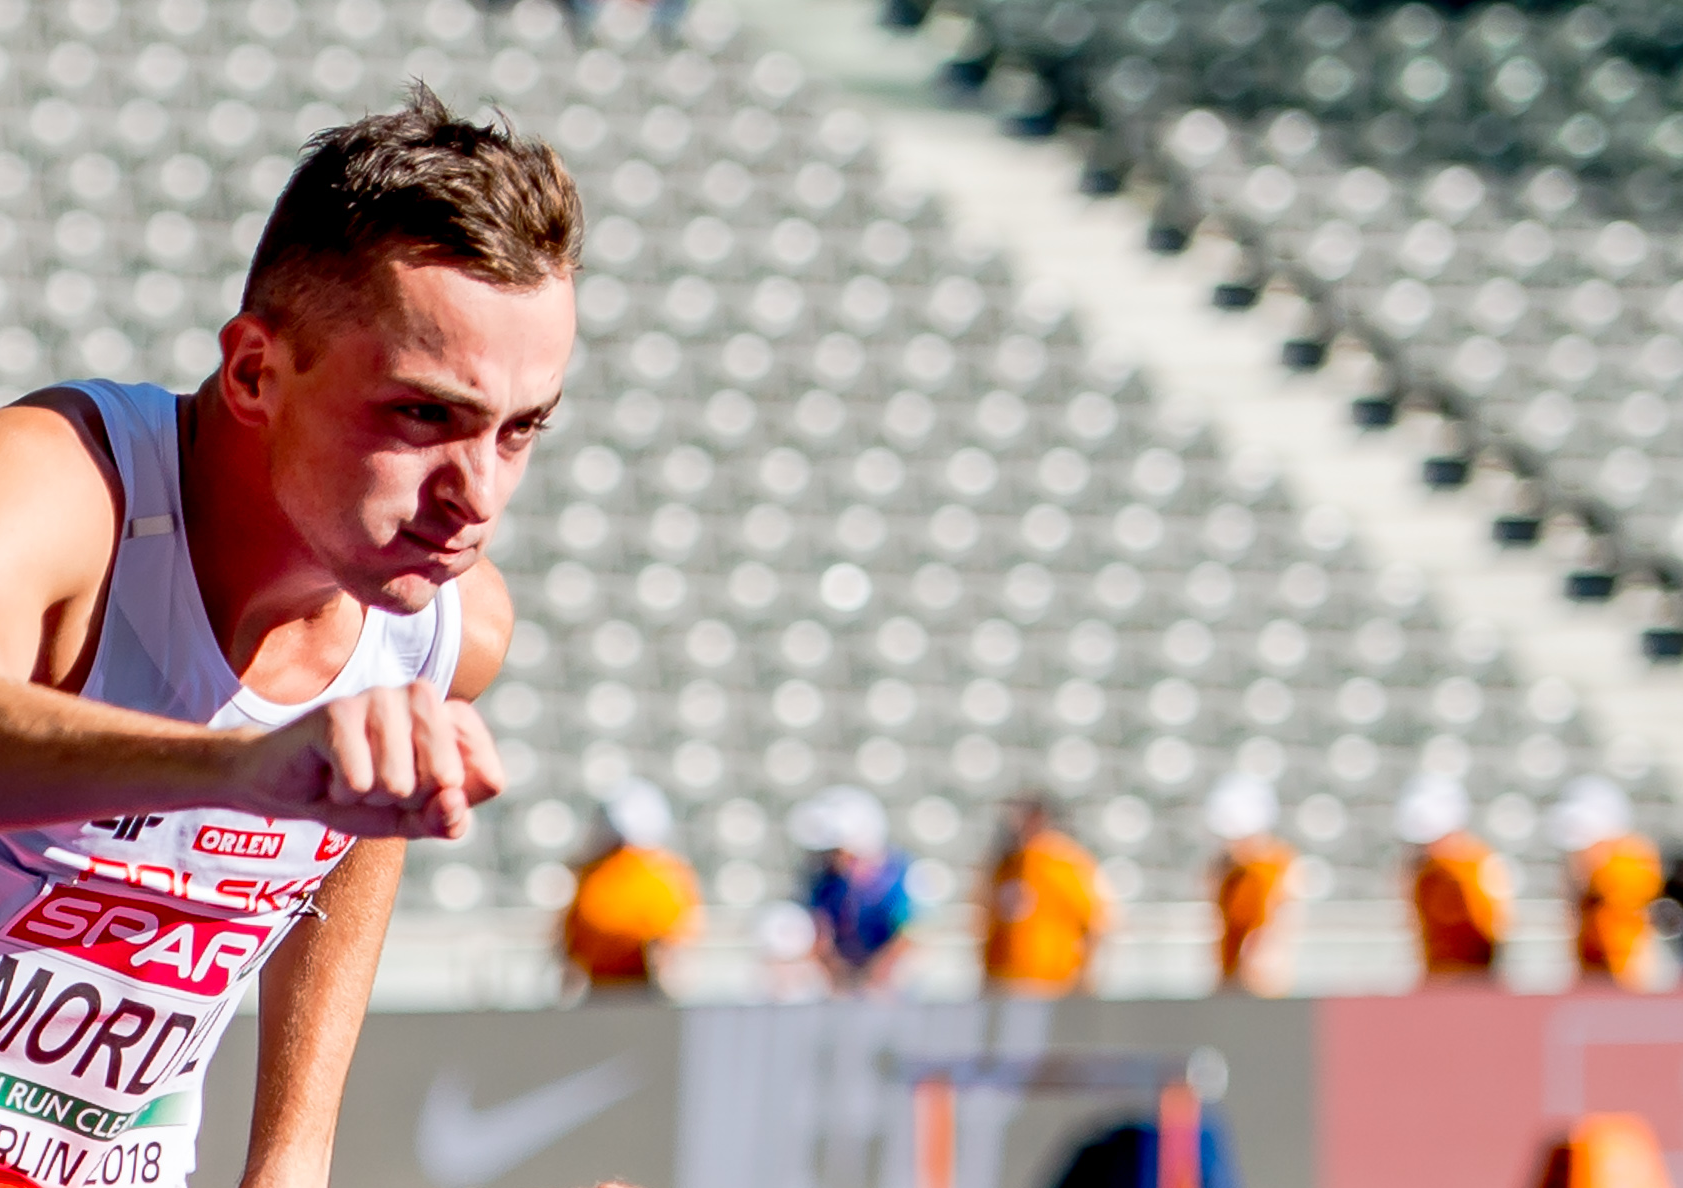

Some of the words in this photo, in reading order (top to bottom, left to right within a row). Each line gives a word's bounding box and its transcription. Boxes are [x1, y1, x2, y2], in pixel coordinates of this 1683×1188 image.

[200, 831, 281, 856] ORLEN
[26, 896, 260, 983] SPAR
[6, 1082, 74, 1123] RUN
[75, 1104, 149, 1140] CLE
